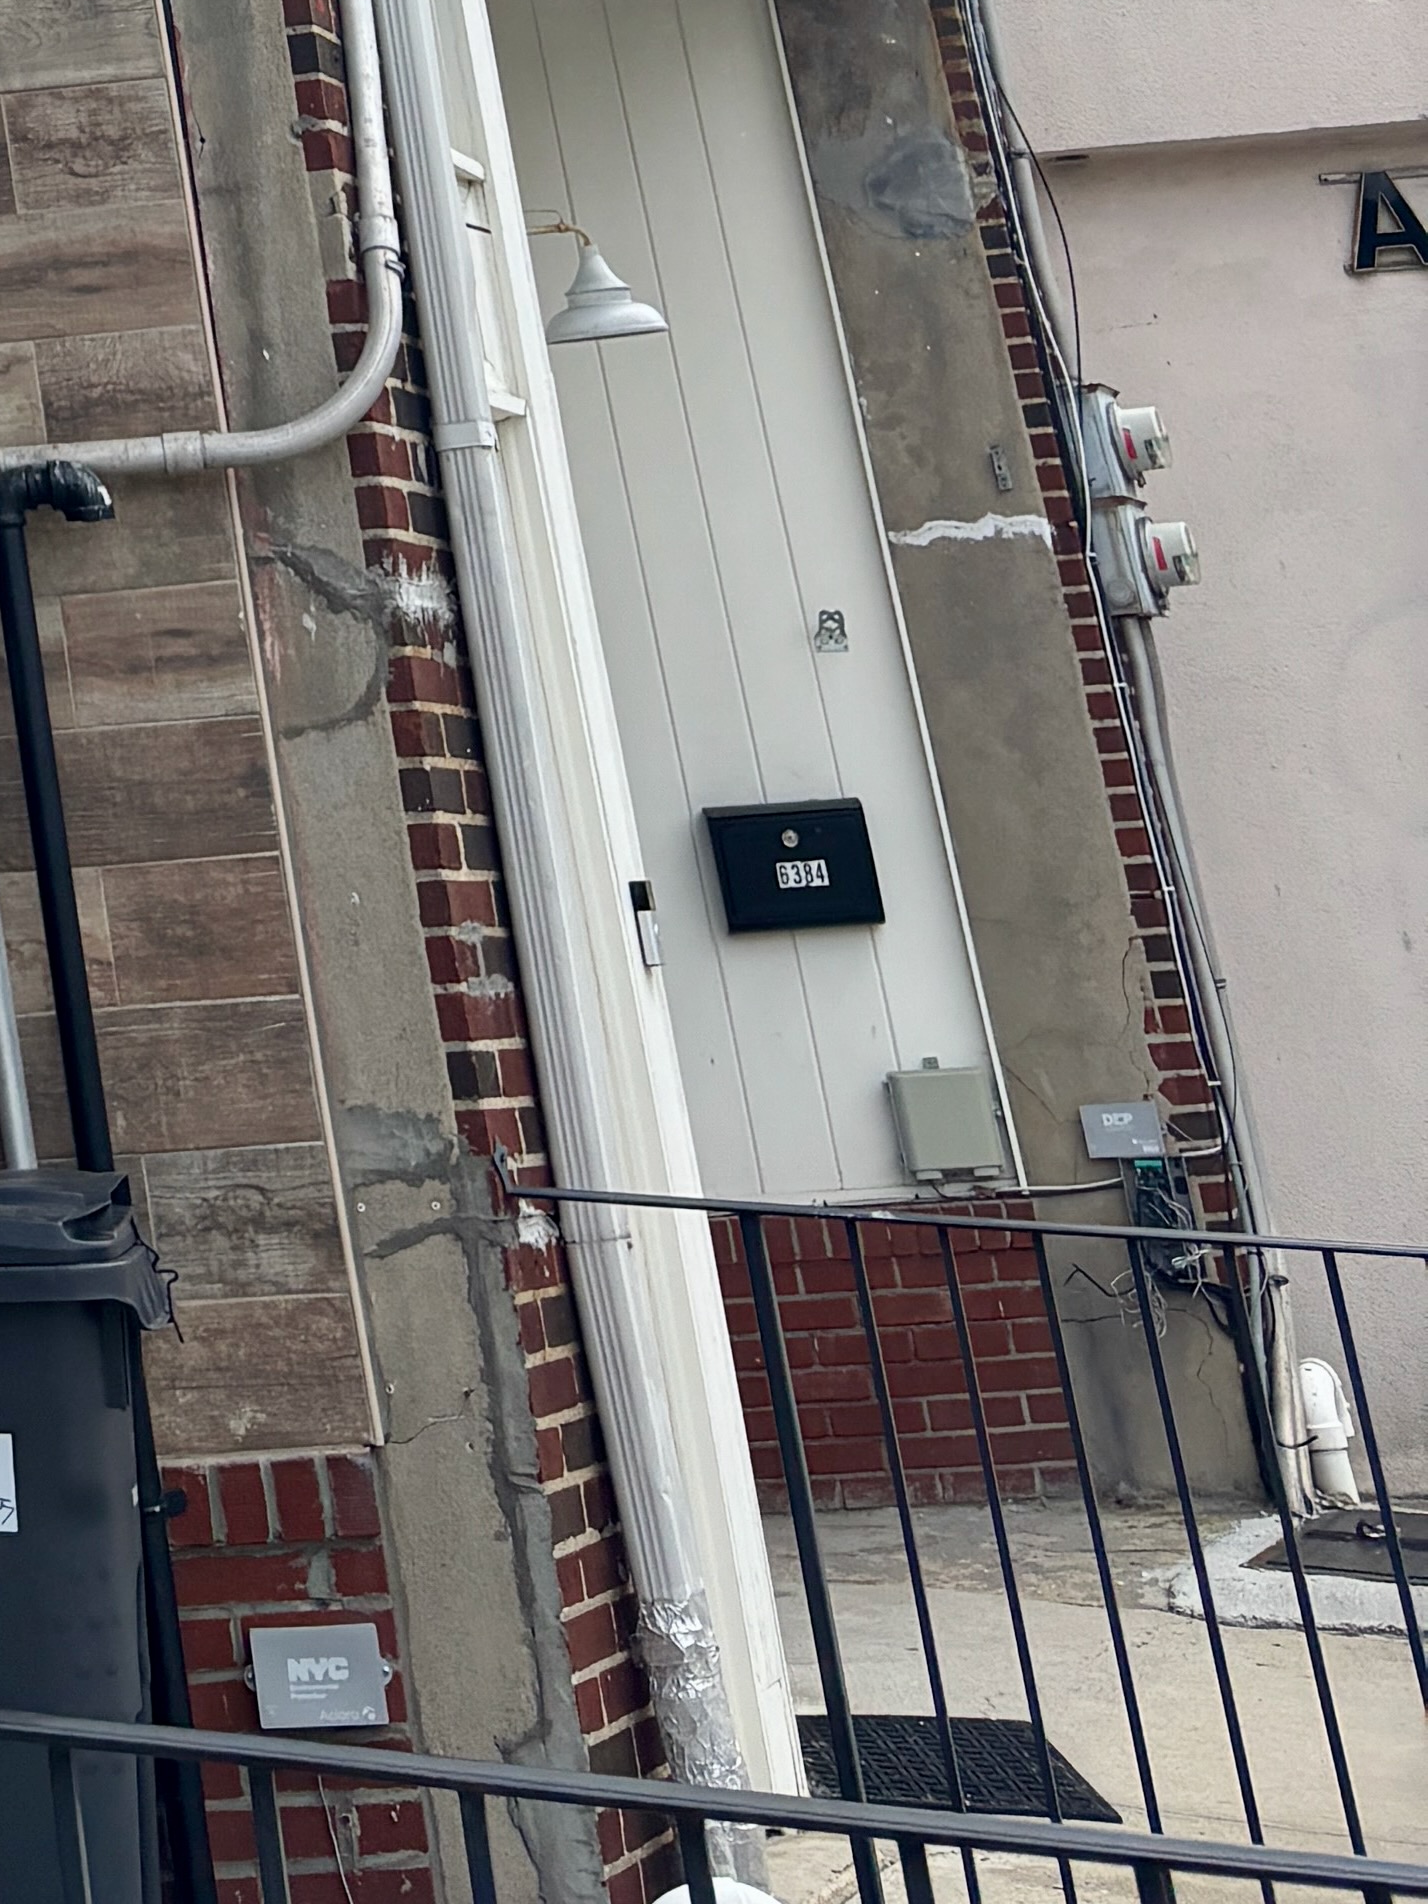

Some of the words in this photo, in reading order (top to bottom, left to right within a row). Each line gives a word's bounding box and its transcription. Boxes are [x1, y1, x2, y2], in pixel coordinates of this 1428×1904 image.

[1354, 170, 1428, 272] A
[779, 862, 825, 885] 6384
[286, 1656, 350, 1683] NYC
